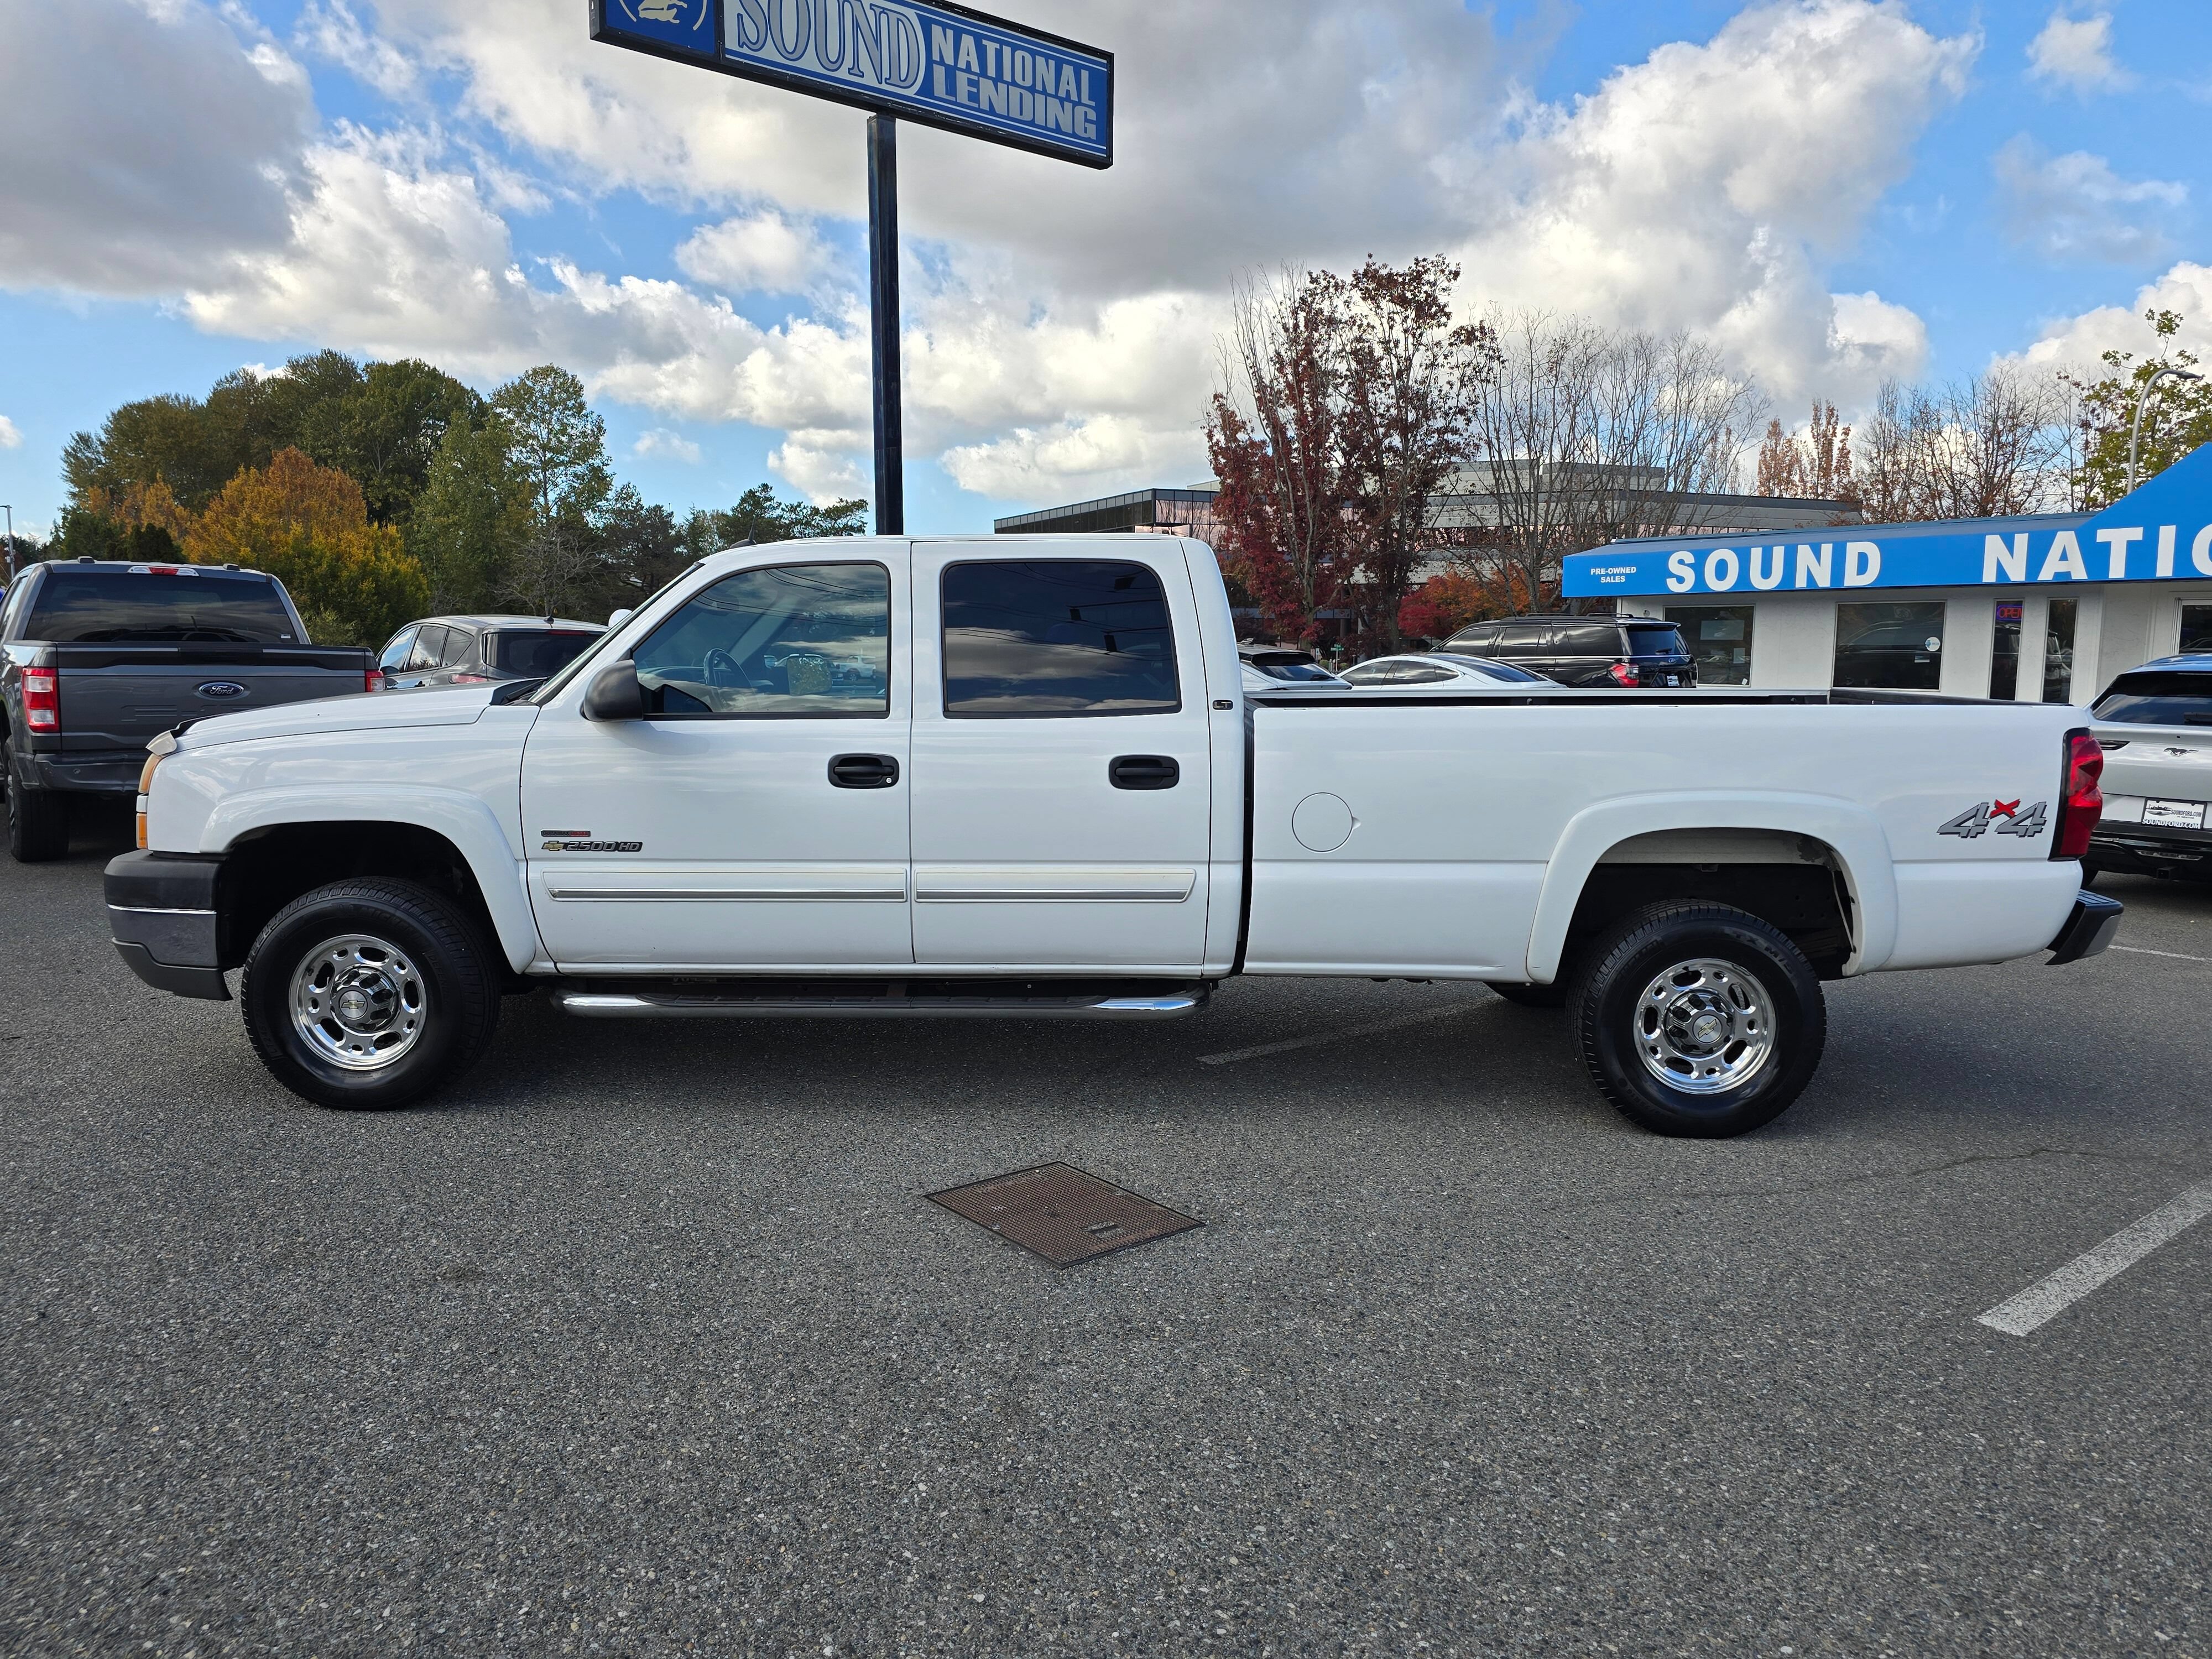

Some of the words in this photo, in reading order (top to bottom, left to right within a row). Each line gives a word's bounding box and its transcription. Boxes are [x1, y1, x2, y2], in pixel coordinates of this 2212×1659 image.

[737, 0, 920, 88] SOUND
[931, 24, 1095, 107] NATIONAL
[933, 64, 1097, 140] LENDING
[1590, 566, 1636, 575] PRE-OWNED
[1666, 541, 1881, 593] SOUND
[210, 686, 234, 694] Ford
[2142, 818, 2201, 830] SOUNDFORD.COM
[566, 842, 617, 851] 2500
